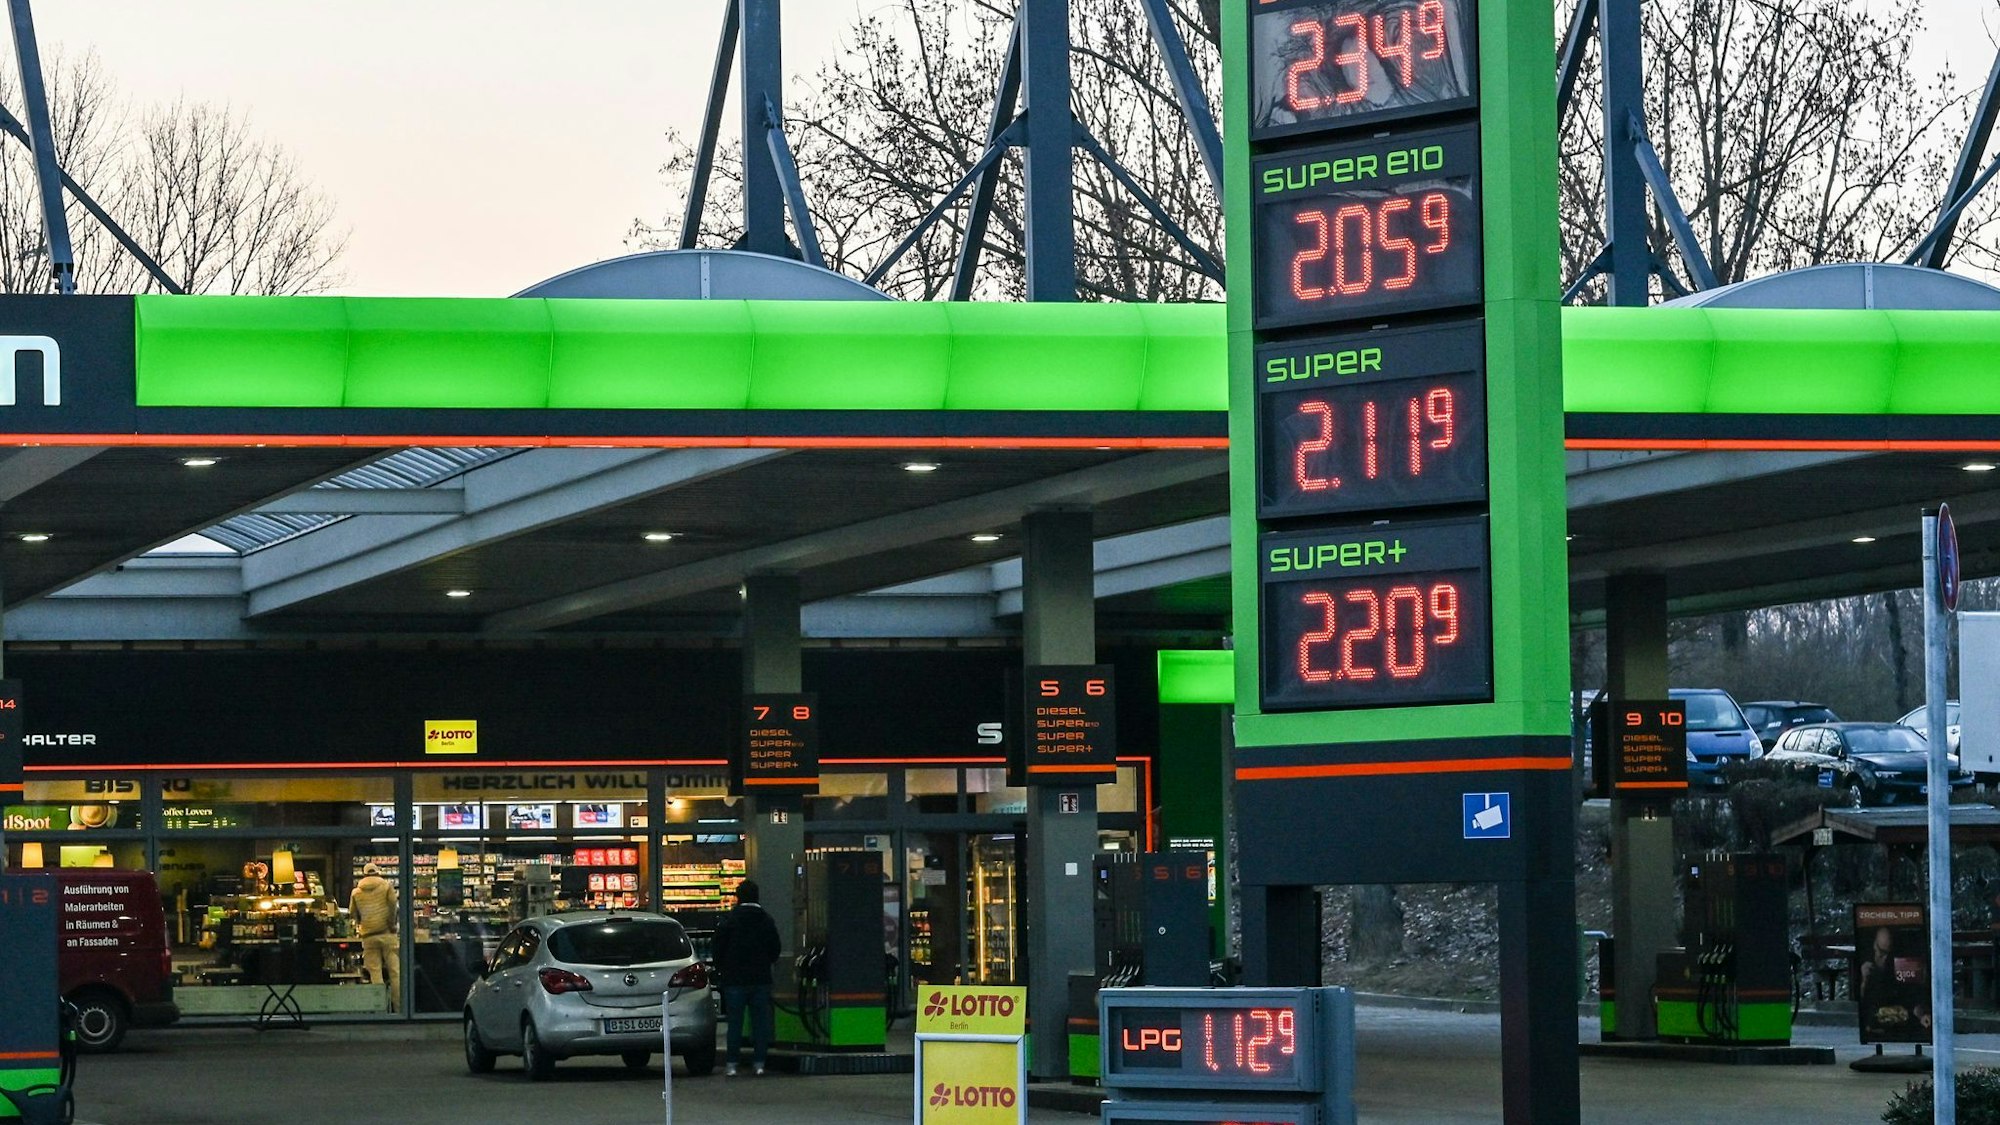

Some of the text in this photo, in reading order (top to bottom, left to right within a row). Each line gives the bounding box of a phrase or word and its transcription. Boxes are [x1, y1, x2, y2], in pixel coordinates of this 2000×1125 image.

[1266, 347, 1382, 383] SUPER
[1269, 539, 1407, 572] SUPER+
[1040, 679, 1106, 696] 5 6
[753, 705, 810, 720] 7 8
[1036, 706, 1087, 716] DIESEL
[1626, 712, 1684, 726] 9 10
[441, 730, 473, 739] LOTTO
[976, 722, 1004, 744] S
[1037, 731, 1085, 741] SUPER
[1037, 744, 1094, 753] SUPER+
[443, 773, 576, 790] HERZLICH
[161, 807, 213, 816] offee Lovers
[64, 885, 129, 896] Ausführung von
[64, 902, 124, 912] Malerarbeiten
[65, 919, 119, 930] in Räumen &
[66, 936, 119, 948] an Fassaden
[951, 994, 1014, 1017] LOTTO
[950, 1021, 969, 1030] Berlin
[1122, 1028, 1182, 1052] LPG
[954, 1086, 1016, 1108] LOTTO
